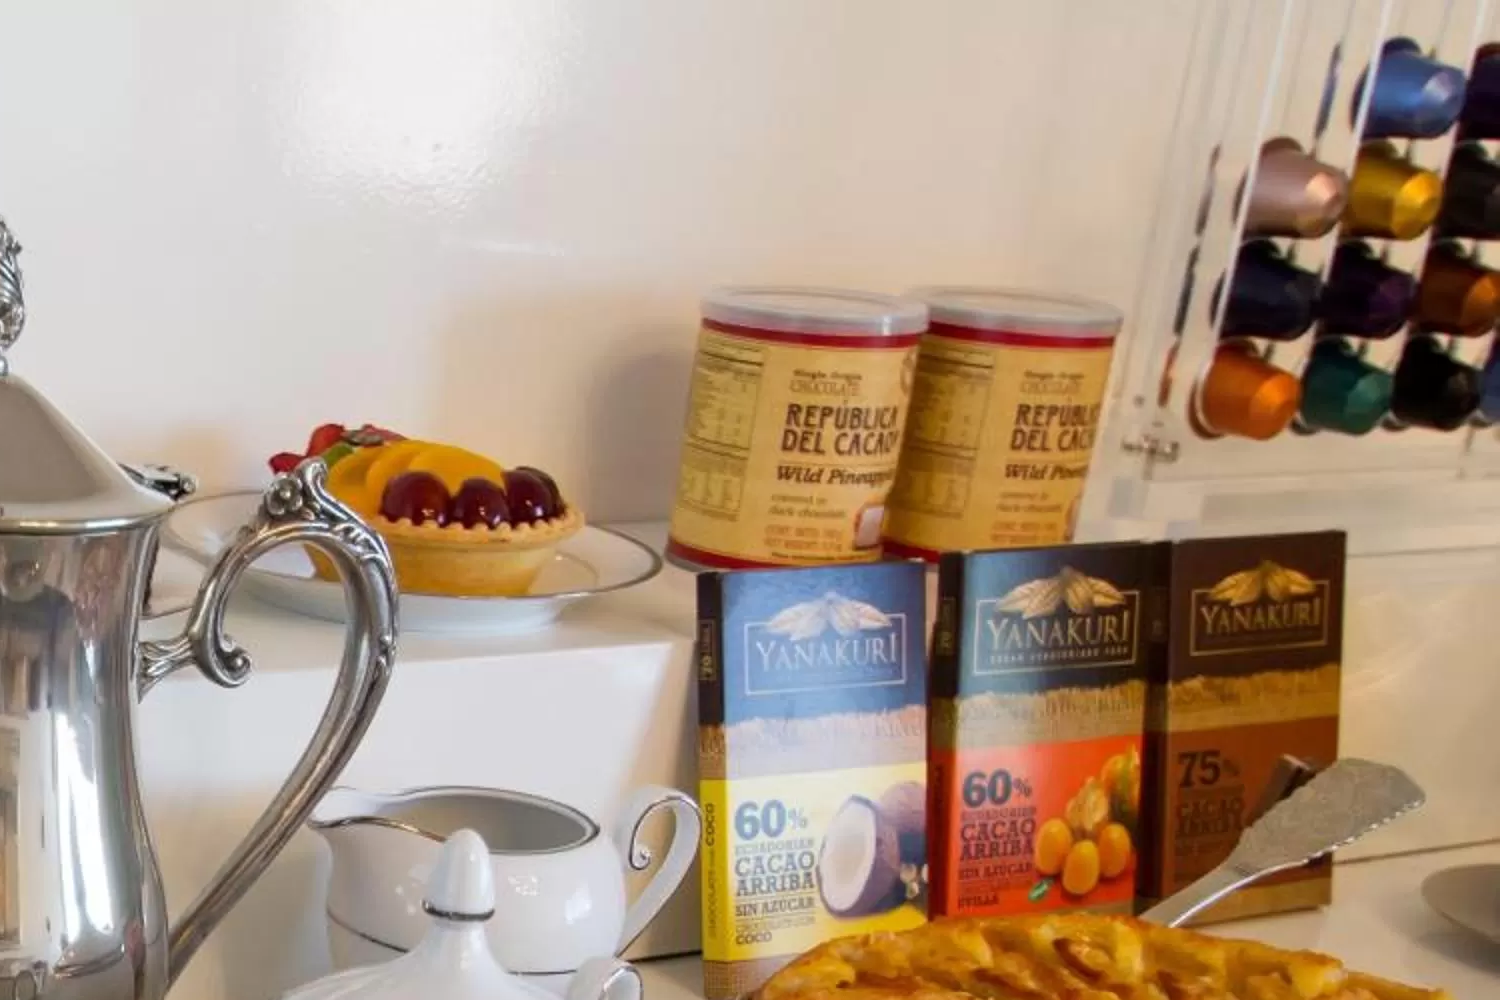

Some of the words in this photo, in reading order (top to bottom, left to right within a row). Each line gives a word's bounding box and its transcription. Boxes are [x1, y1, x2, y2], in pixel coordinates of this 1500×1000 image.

[780, 429, 826, 455] DEL
[1010, 428, 1049, 451] DEL
[776, 465, 824, 484] Wild
[1200, 596, 1321, 636] YANAKURI
[986, 609, 1130, 651] YANAKURI
[754, 632, 898, 672] YANAKURI
[963, 768, 1033, 809] 60%
[734, 799, 809, 841] 60%
[961, 818, 1036, 842] CACAO
[960, 838, 1035, 861] ARRIBA
[735, 850, 815, 877] CACAO
[736, 871, 815, 897] ARRIBA
